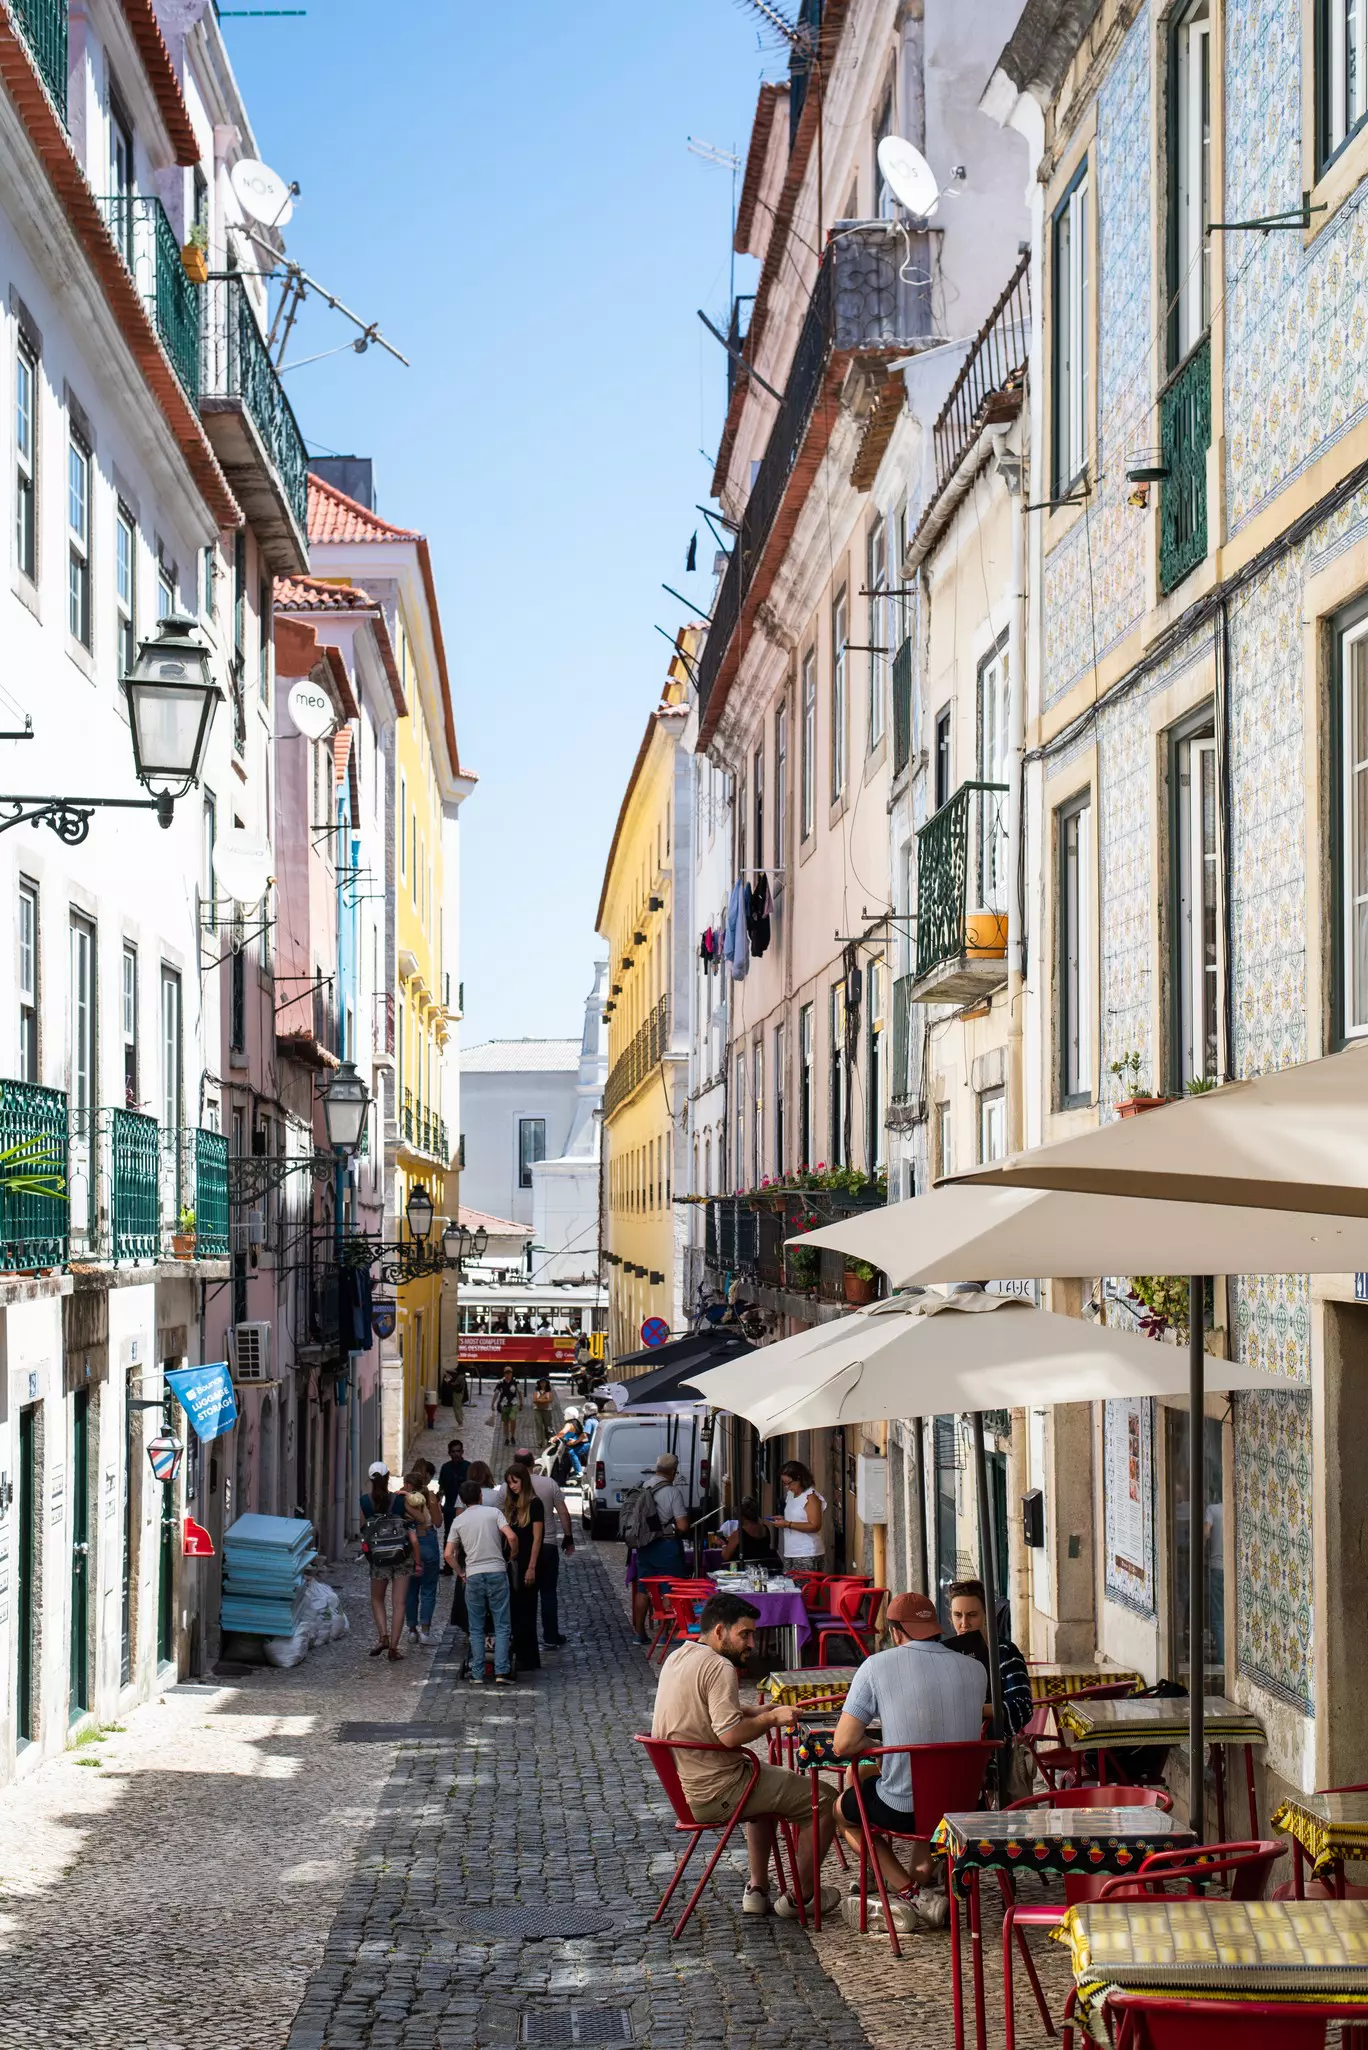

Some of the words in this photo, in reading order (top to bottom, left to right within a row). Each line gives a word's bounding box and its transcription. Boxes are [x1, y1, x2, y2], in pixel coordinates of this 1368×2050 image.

[243, 177, 274, 195] NOS
[296, 693, 325, 708] meo
[191, 1386, 230, 1412] LUGGAGE
[197, 1396, 233, 1421] STORAGE
